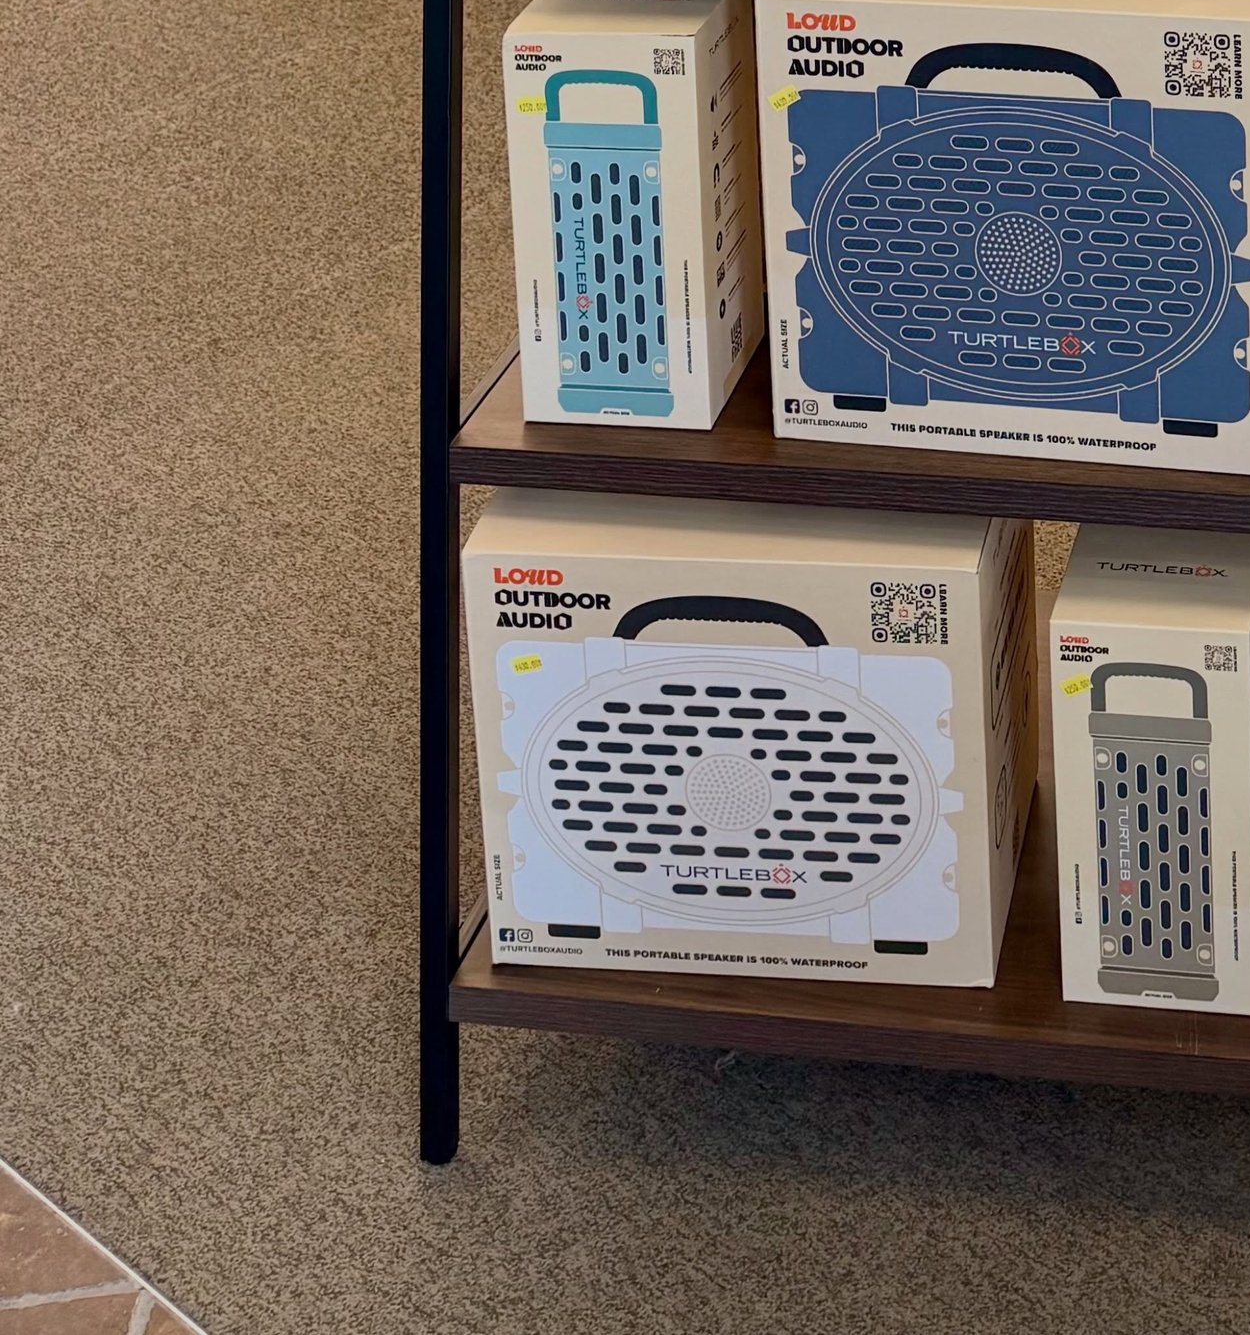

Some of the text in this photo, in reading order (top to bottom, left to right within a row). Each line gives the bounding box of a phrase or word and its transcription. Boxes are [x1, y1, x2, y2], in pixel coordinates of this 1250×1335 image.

[786, 12, 856, 31] LOUD
[787, 34, 903, 57] OUTDOOR
[788, 58, 864, 79] AUDIO
[1233, 34, 1243, 100] LEARN MORE
[574, 217, 593, 320] TURTLEBOX
[948, 331, 1096, 356] TURTLEBOX
[891, 422, 1157, 451] THIS PORTABLE SPEAKER IS 100% WATERPROOF
[494, 567, 564, 586] LOUD
[1097, 562, 1228, 577] TURTLEBOX
[495, 589, 611, 611] OUTDOOR
[496, 611, 572, 631] AUDIO
[939, 583, 948, 645] LEARN MORE
[1118, 805, 1133, 905] TURTLEBOX
[660, 863, 807, 884] TURTLEBOX
[605, 949, 868, 969] THIS PORTABLE SPEAKER IS 100% WATERPROOF
